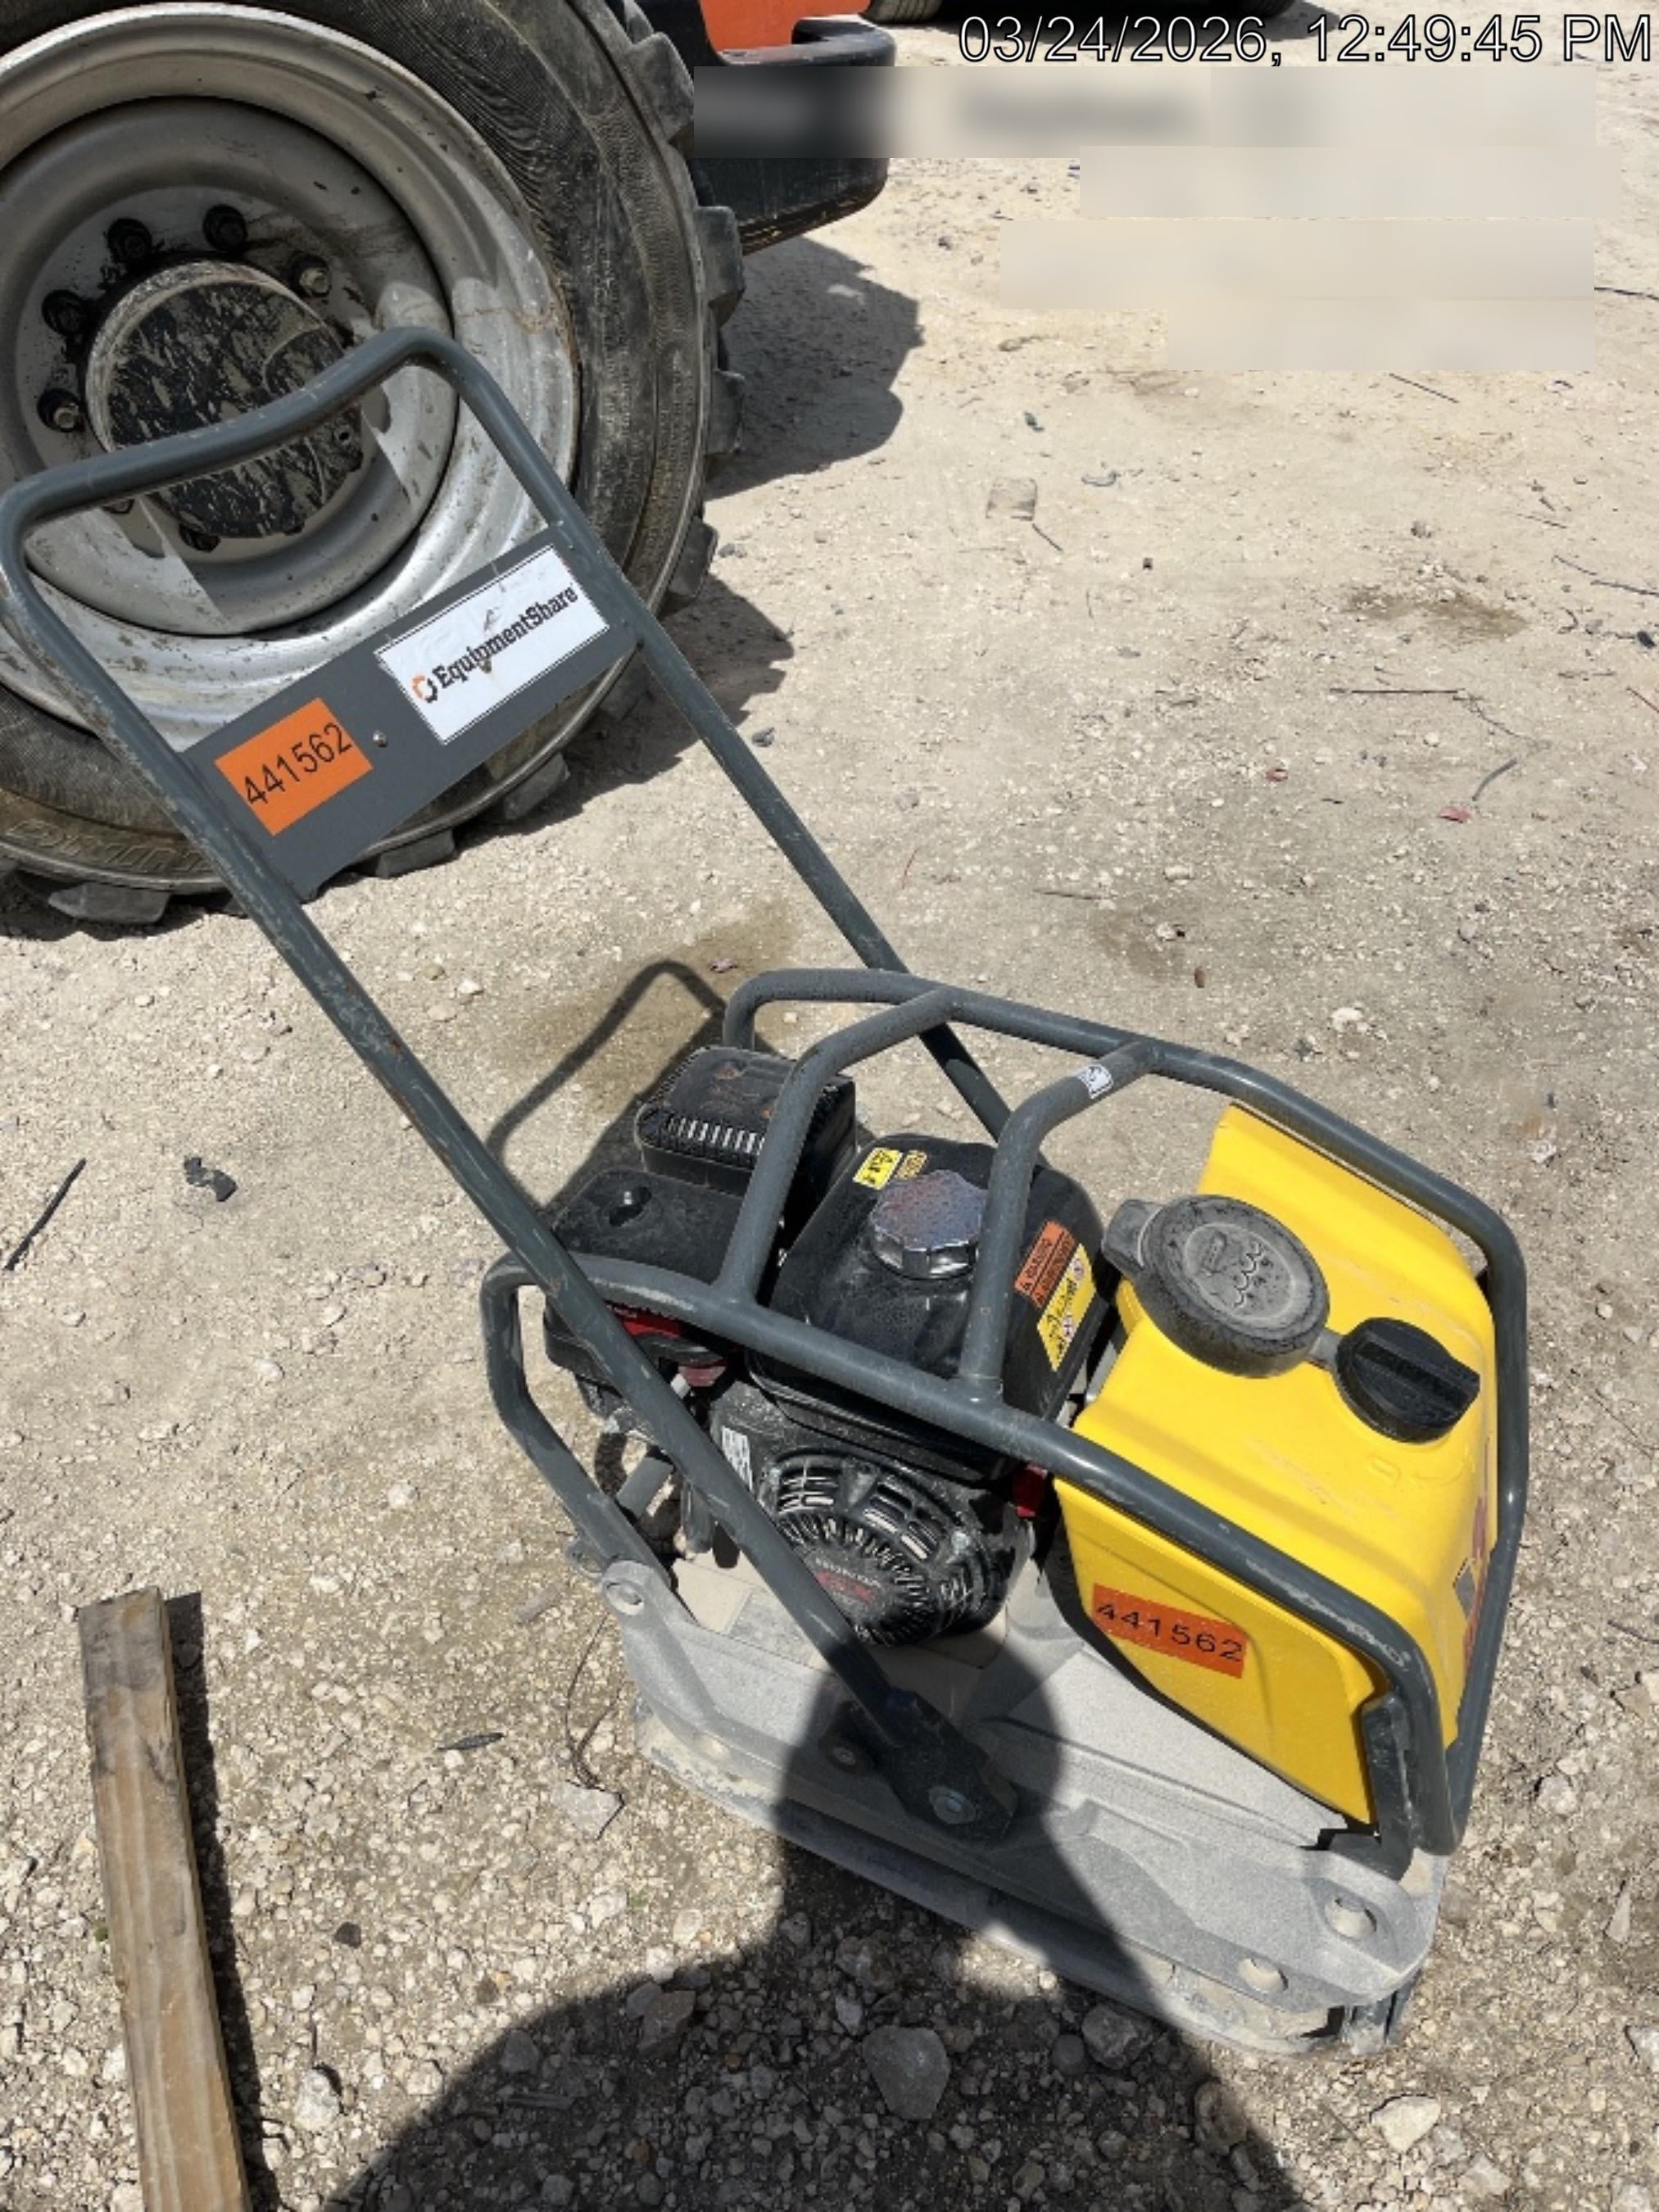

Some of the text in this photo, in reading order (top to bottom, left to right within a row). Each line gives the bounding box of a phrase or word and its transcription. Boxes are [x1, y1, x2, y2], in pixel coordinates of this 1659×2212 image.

[434, 585, 580, 690] EquipmentShare
[243, 722, 354, 808] 441562
[1096, 1603, 1244, 1662] 441562
